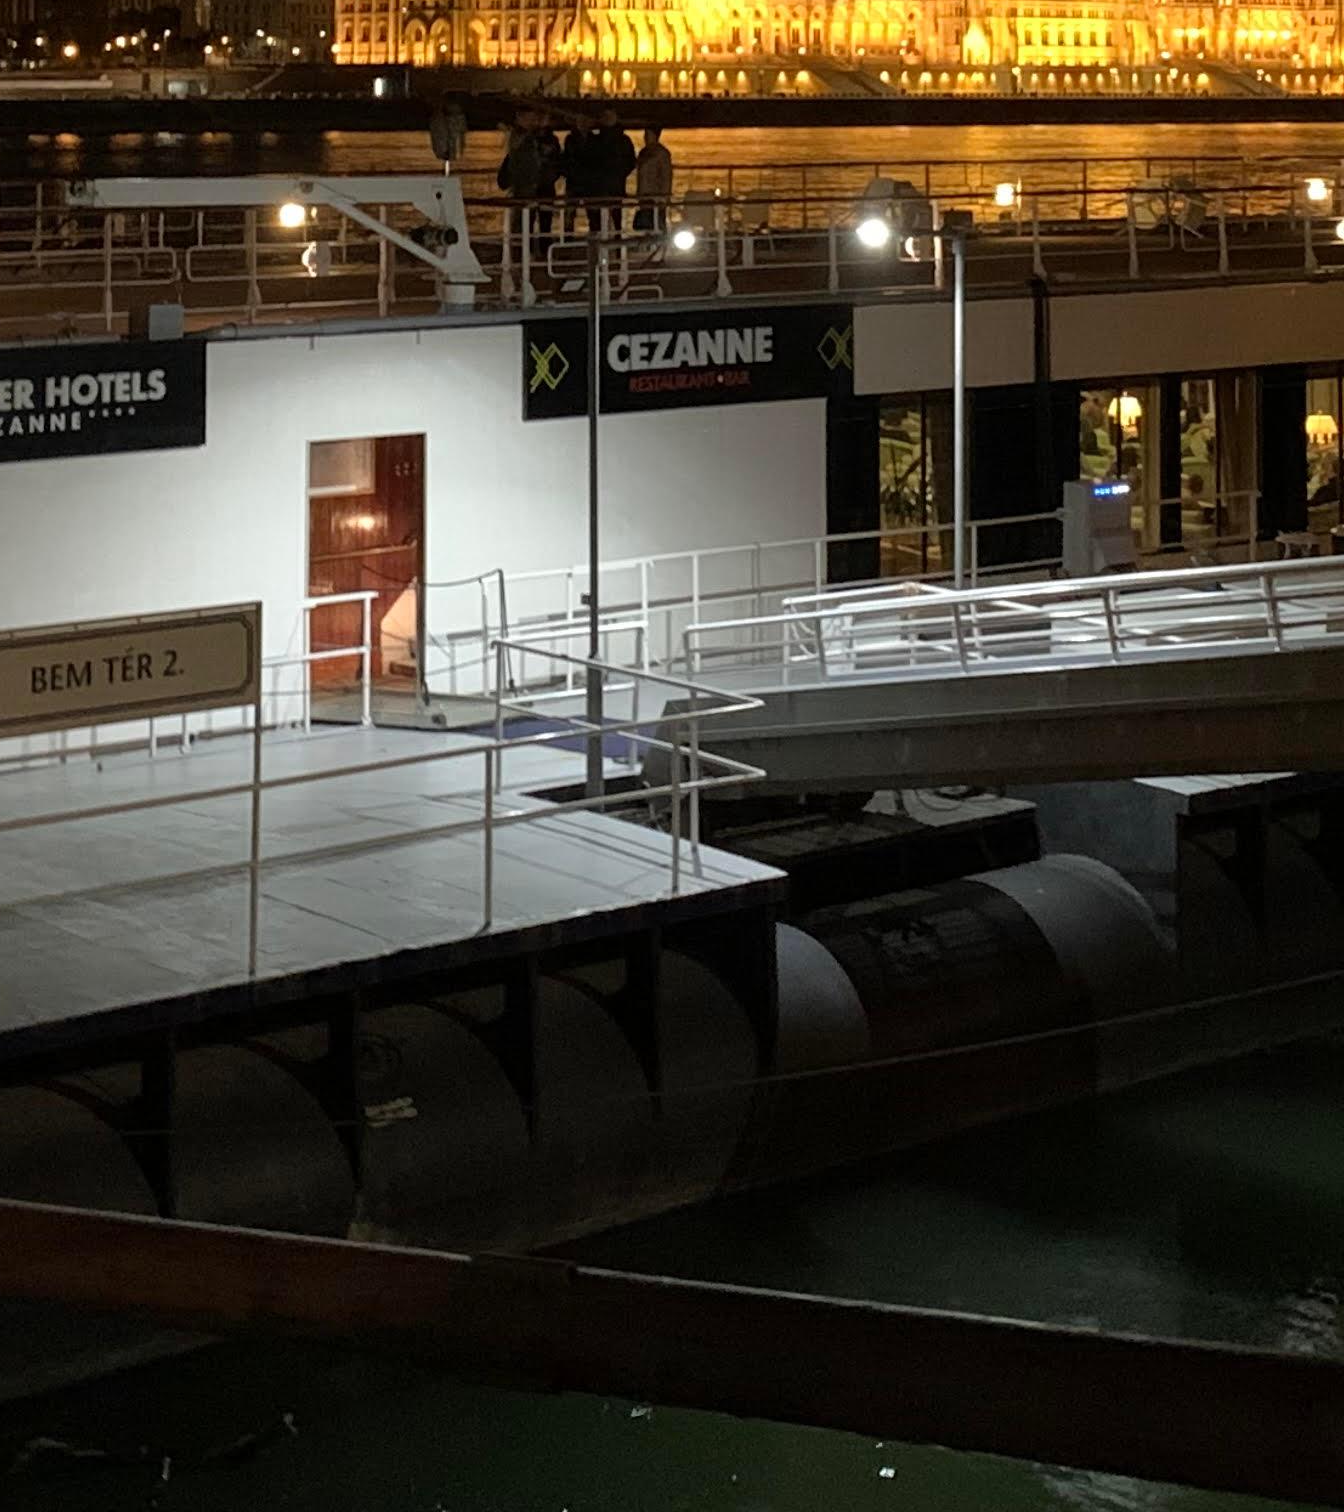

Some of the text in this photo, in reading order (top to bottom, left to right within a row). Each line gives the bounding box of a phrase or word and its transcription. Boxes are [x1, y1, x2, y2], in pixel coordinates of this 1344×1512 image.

[607, 326, 773, 372] CEZANNE
[45, 369, 167, 408] HOTELS
[31, 646, 185, 694] BEM TÉR 2.
